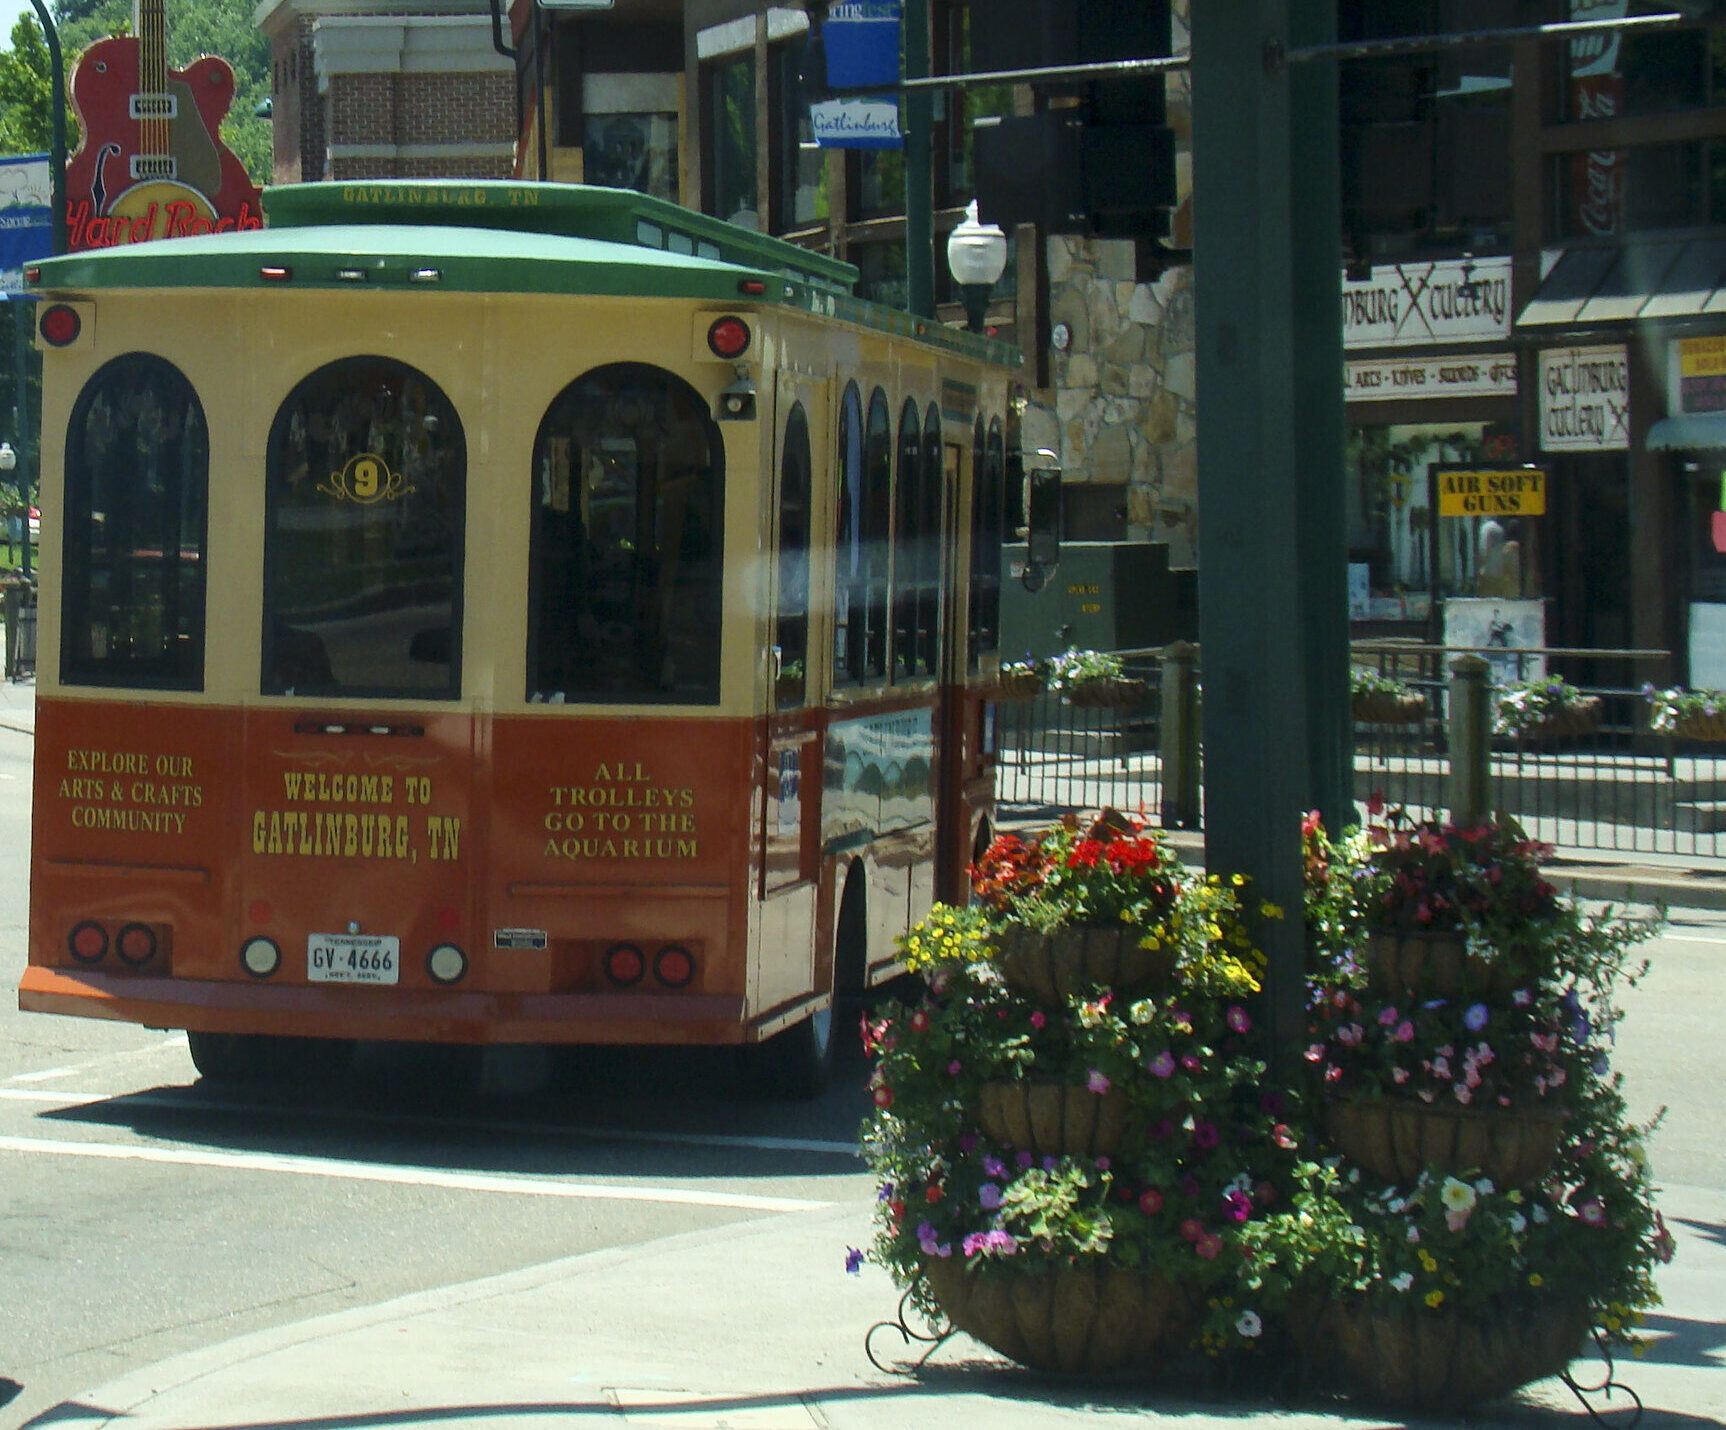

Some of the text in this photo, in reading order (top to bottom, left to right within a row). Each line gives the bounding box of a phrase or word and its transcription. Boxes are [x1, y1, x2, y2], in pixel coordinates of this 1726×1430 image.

[813, 111, 896, 136] Gatlinburg
[507, 189, 539, 206] TN
[66, 200, 260, 247] Hard Rock
[354, 460, 379, 497] 9
[1443, 475, 1542, 494] AIR SOFT
[1463, 494, 1521, 512] GUNS
[67, 749, 193, 777] EXPLORE OUR
[594, 762, 650, 782] ALL
[59, 778, 203, 807] ARTS & CRAFTS
[284, 772, 432, 805] WELCOME TO
[549, 787, 694, 808] TROLLEYS
[70, 806, 187, 834] COMMUNITY
[544, 812, 696, 833] GO TO THE
[253, 810, 461, 865] GATLINBURG, TN
[543, 838, 698, 860] AQUARIUM
